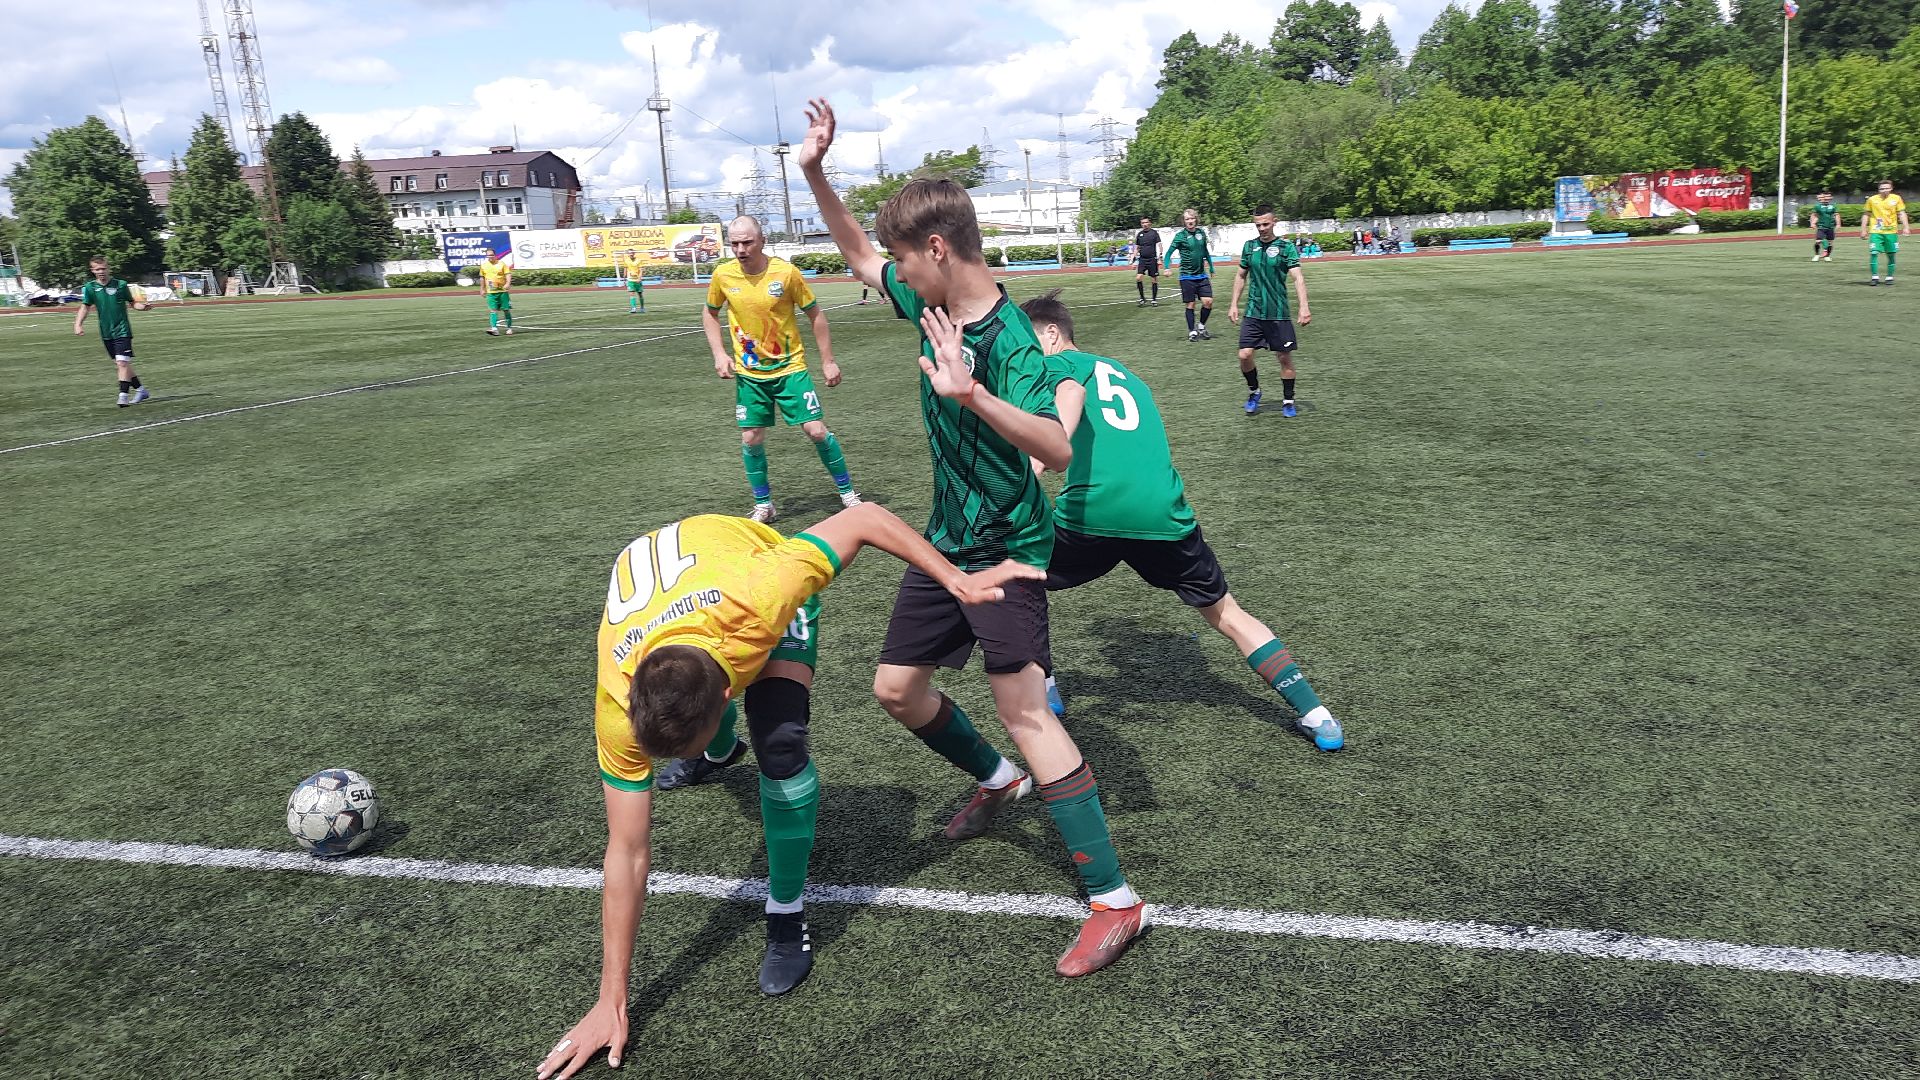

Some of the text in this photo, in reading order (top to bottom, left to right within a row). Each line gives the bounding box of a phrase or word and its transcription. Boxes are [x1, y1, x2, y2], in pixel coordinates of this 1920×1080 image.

[1657, 174, 1746, 187] Я выбираю
[1695, 185, 1746, 198] спорт!
[445, 236, 484, 248] Спорт
[803, 390, 821, 411] 21
[1093, 360, 1140, 432] 5
[606, 521, 697, 626] 10
[696, 588, 721, 608] ФК
